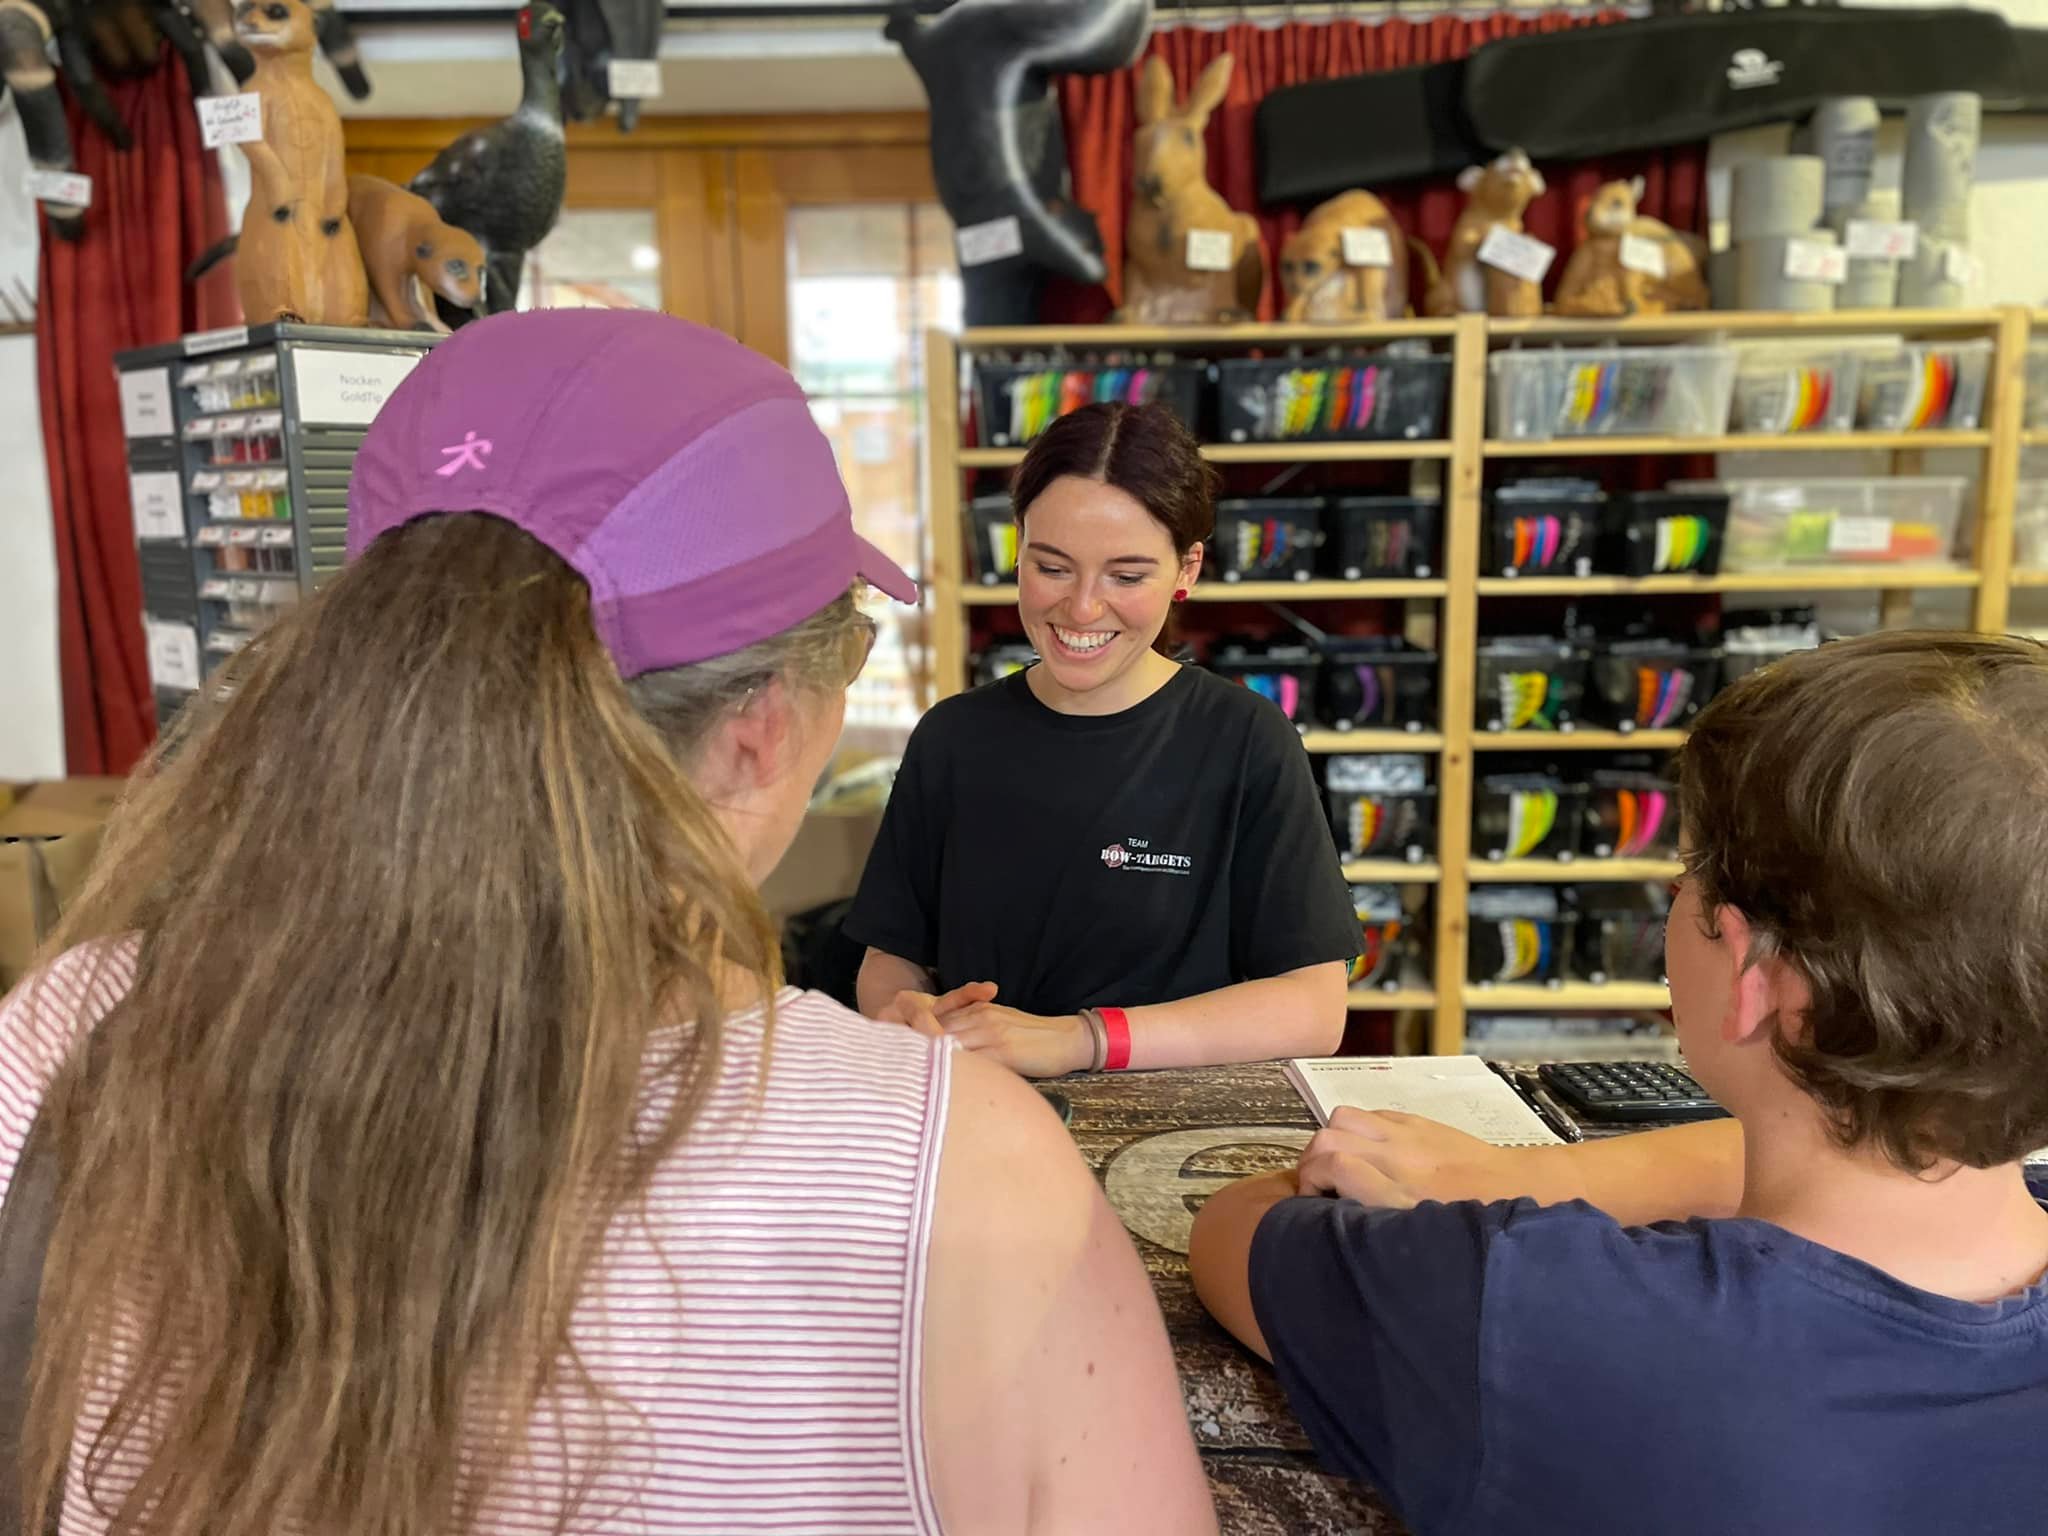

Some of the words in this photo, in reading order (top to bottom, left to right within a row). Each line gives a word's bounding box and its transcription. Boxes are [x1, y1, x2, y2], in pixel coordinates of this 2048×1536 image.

[339, 374, 382, 386] Nocken
[340, 391, 382, 404] GoldTip
[1128, 838, 1149, 848] TEAM
[1101, 848, 1192, 868] BOW-TARGETS
